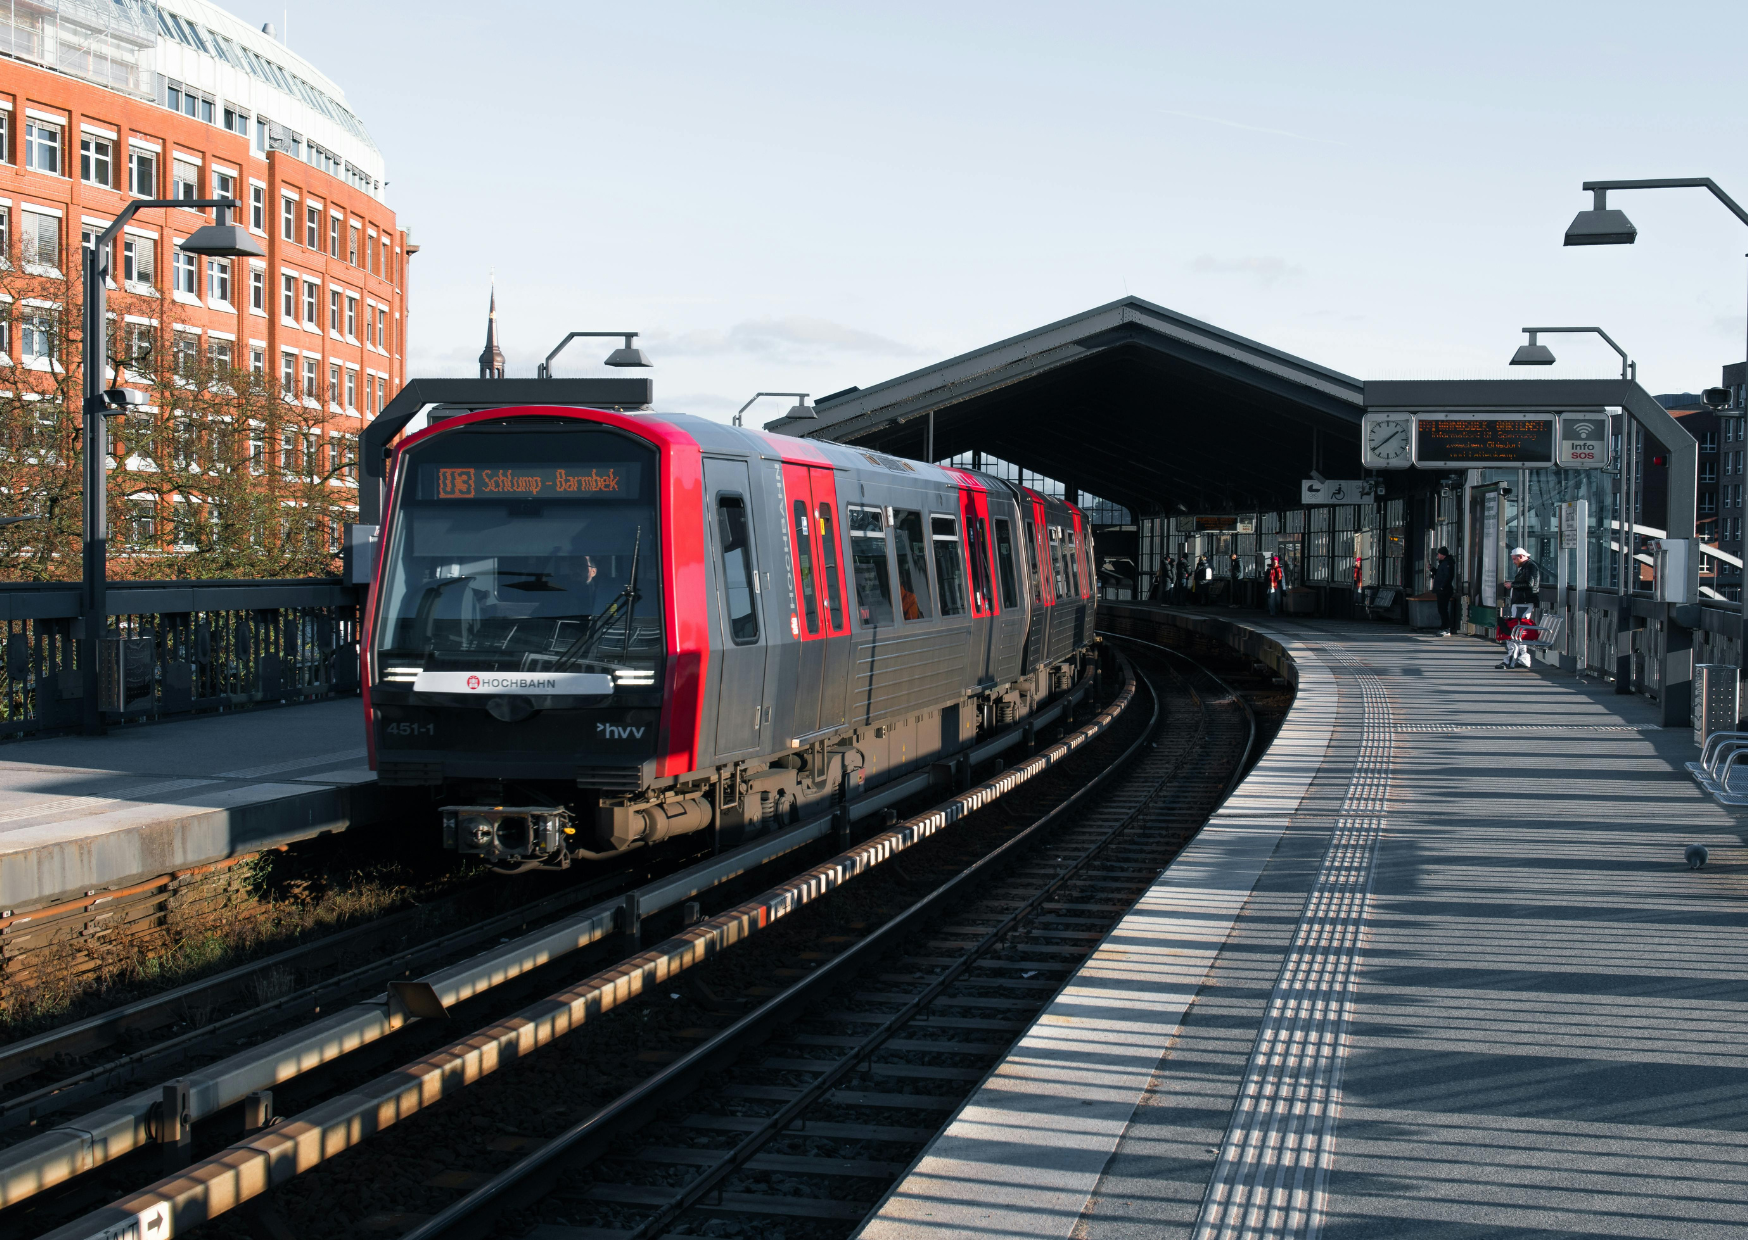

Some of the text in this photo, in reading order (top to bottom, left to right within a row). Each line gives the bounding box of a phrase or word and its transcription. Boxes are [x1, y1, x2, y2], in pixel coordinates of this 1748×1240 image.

[1571, 442, 1595, 451] Info
[1571, 452, 1595, 460] SOS
[439, 469, 475, 498] U3
[482, 469, 542, 495] Schlump
[556, 468, 619, 491] Barmbek
[774, 464, 795, 608] HOCHBAHN
[482, 678, 556, 689] HOCHBAHN
[387, 722, 435, 736] 451-1
